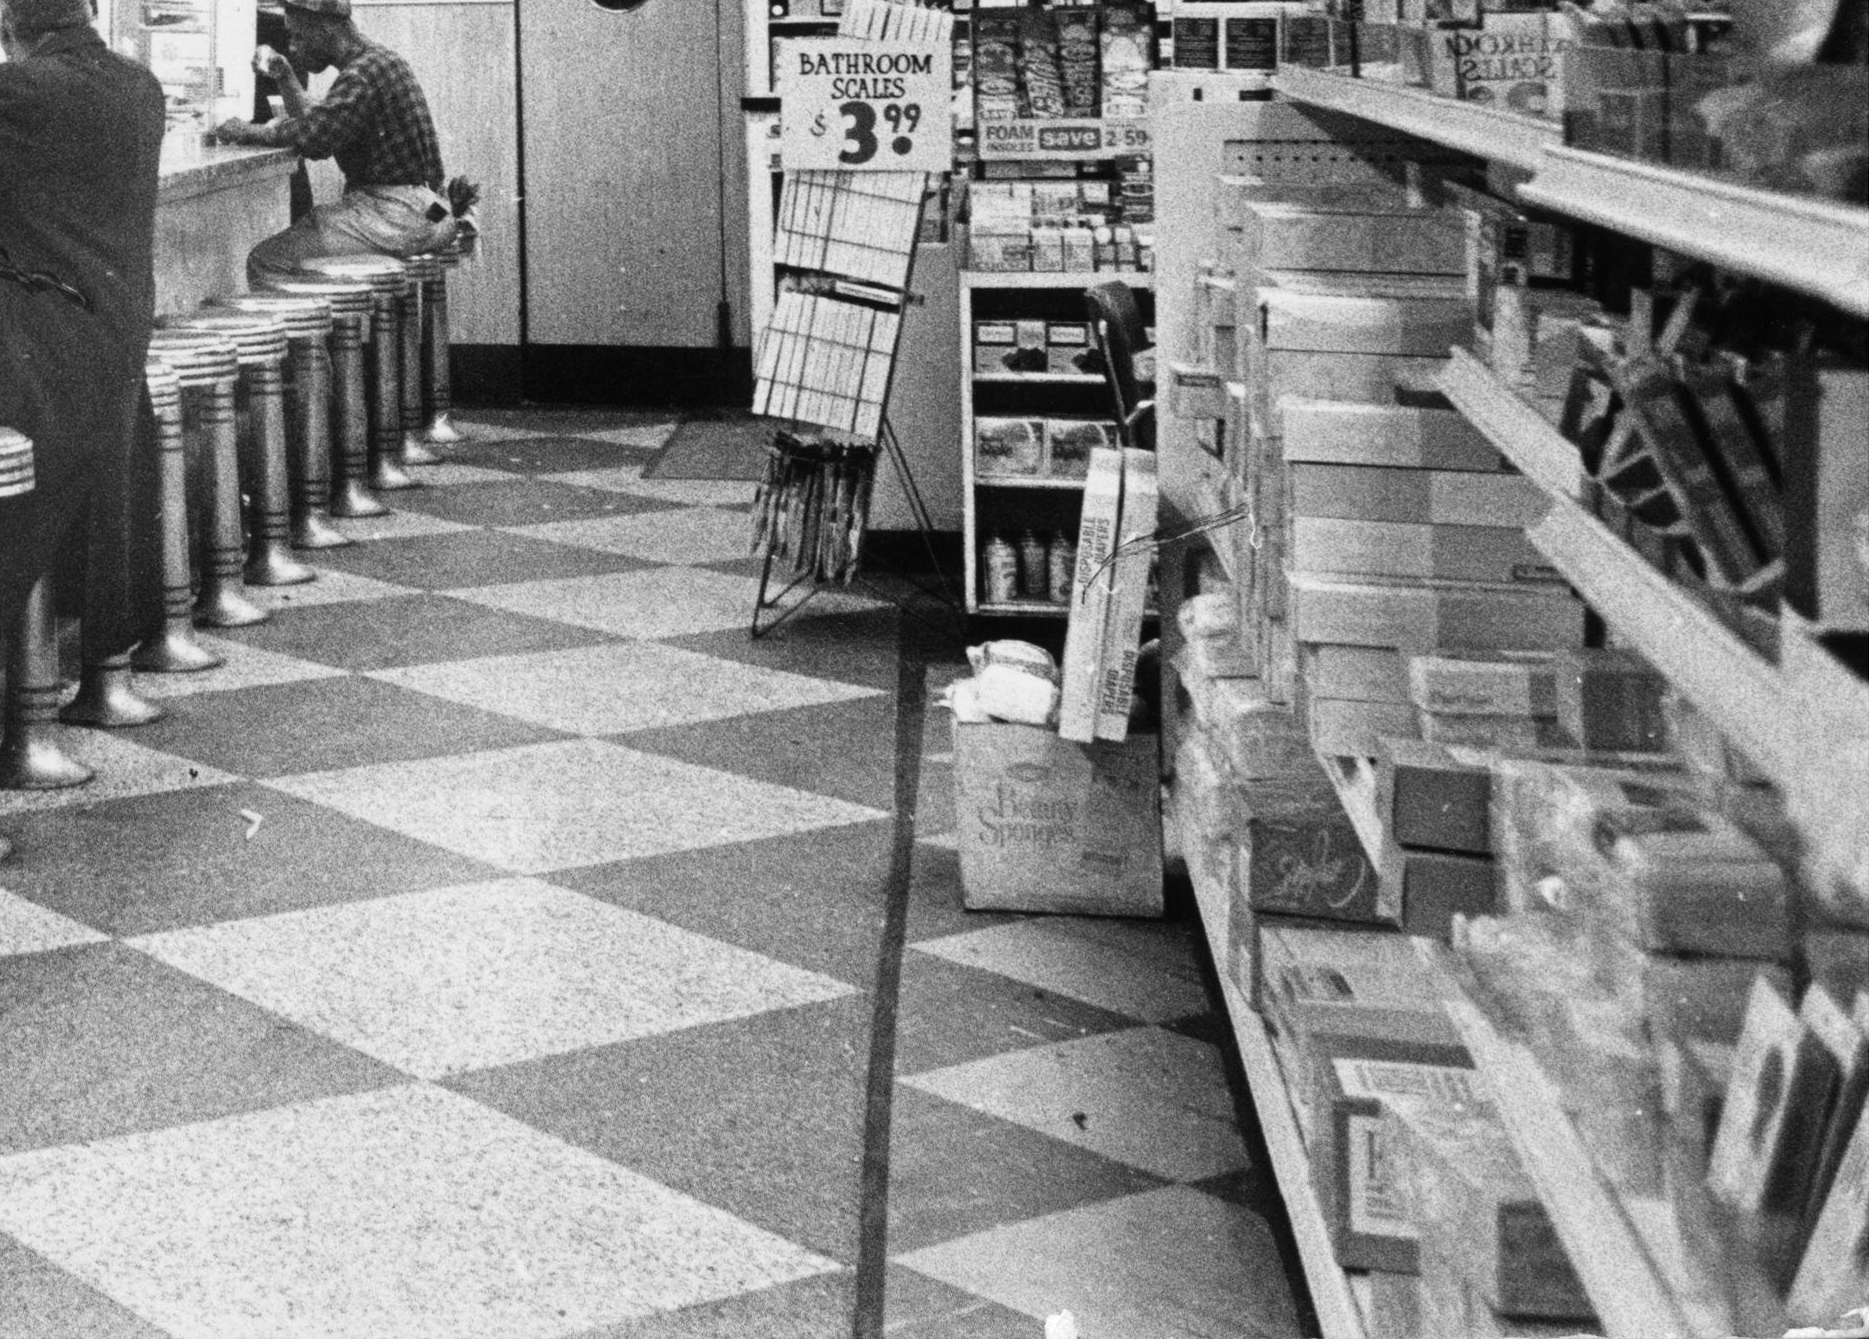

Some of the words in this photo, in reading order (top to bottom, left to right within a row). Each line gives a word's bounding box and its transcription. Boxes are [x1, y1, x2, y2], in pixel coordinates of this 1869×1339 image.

[799, 53, 933, 75] BATHROOM
[831, 78, 906, 99] SCALES
[986, 125, 1035, 140] FOAM
[1042, 131, 1097, 147] save
